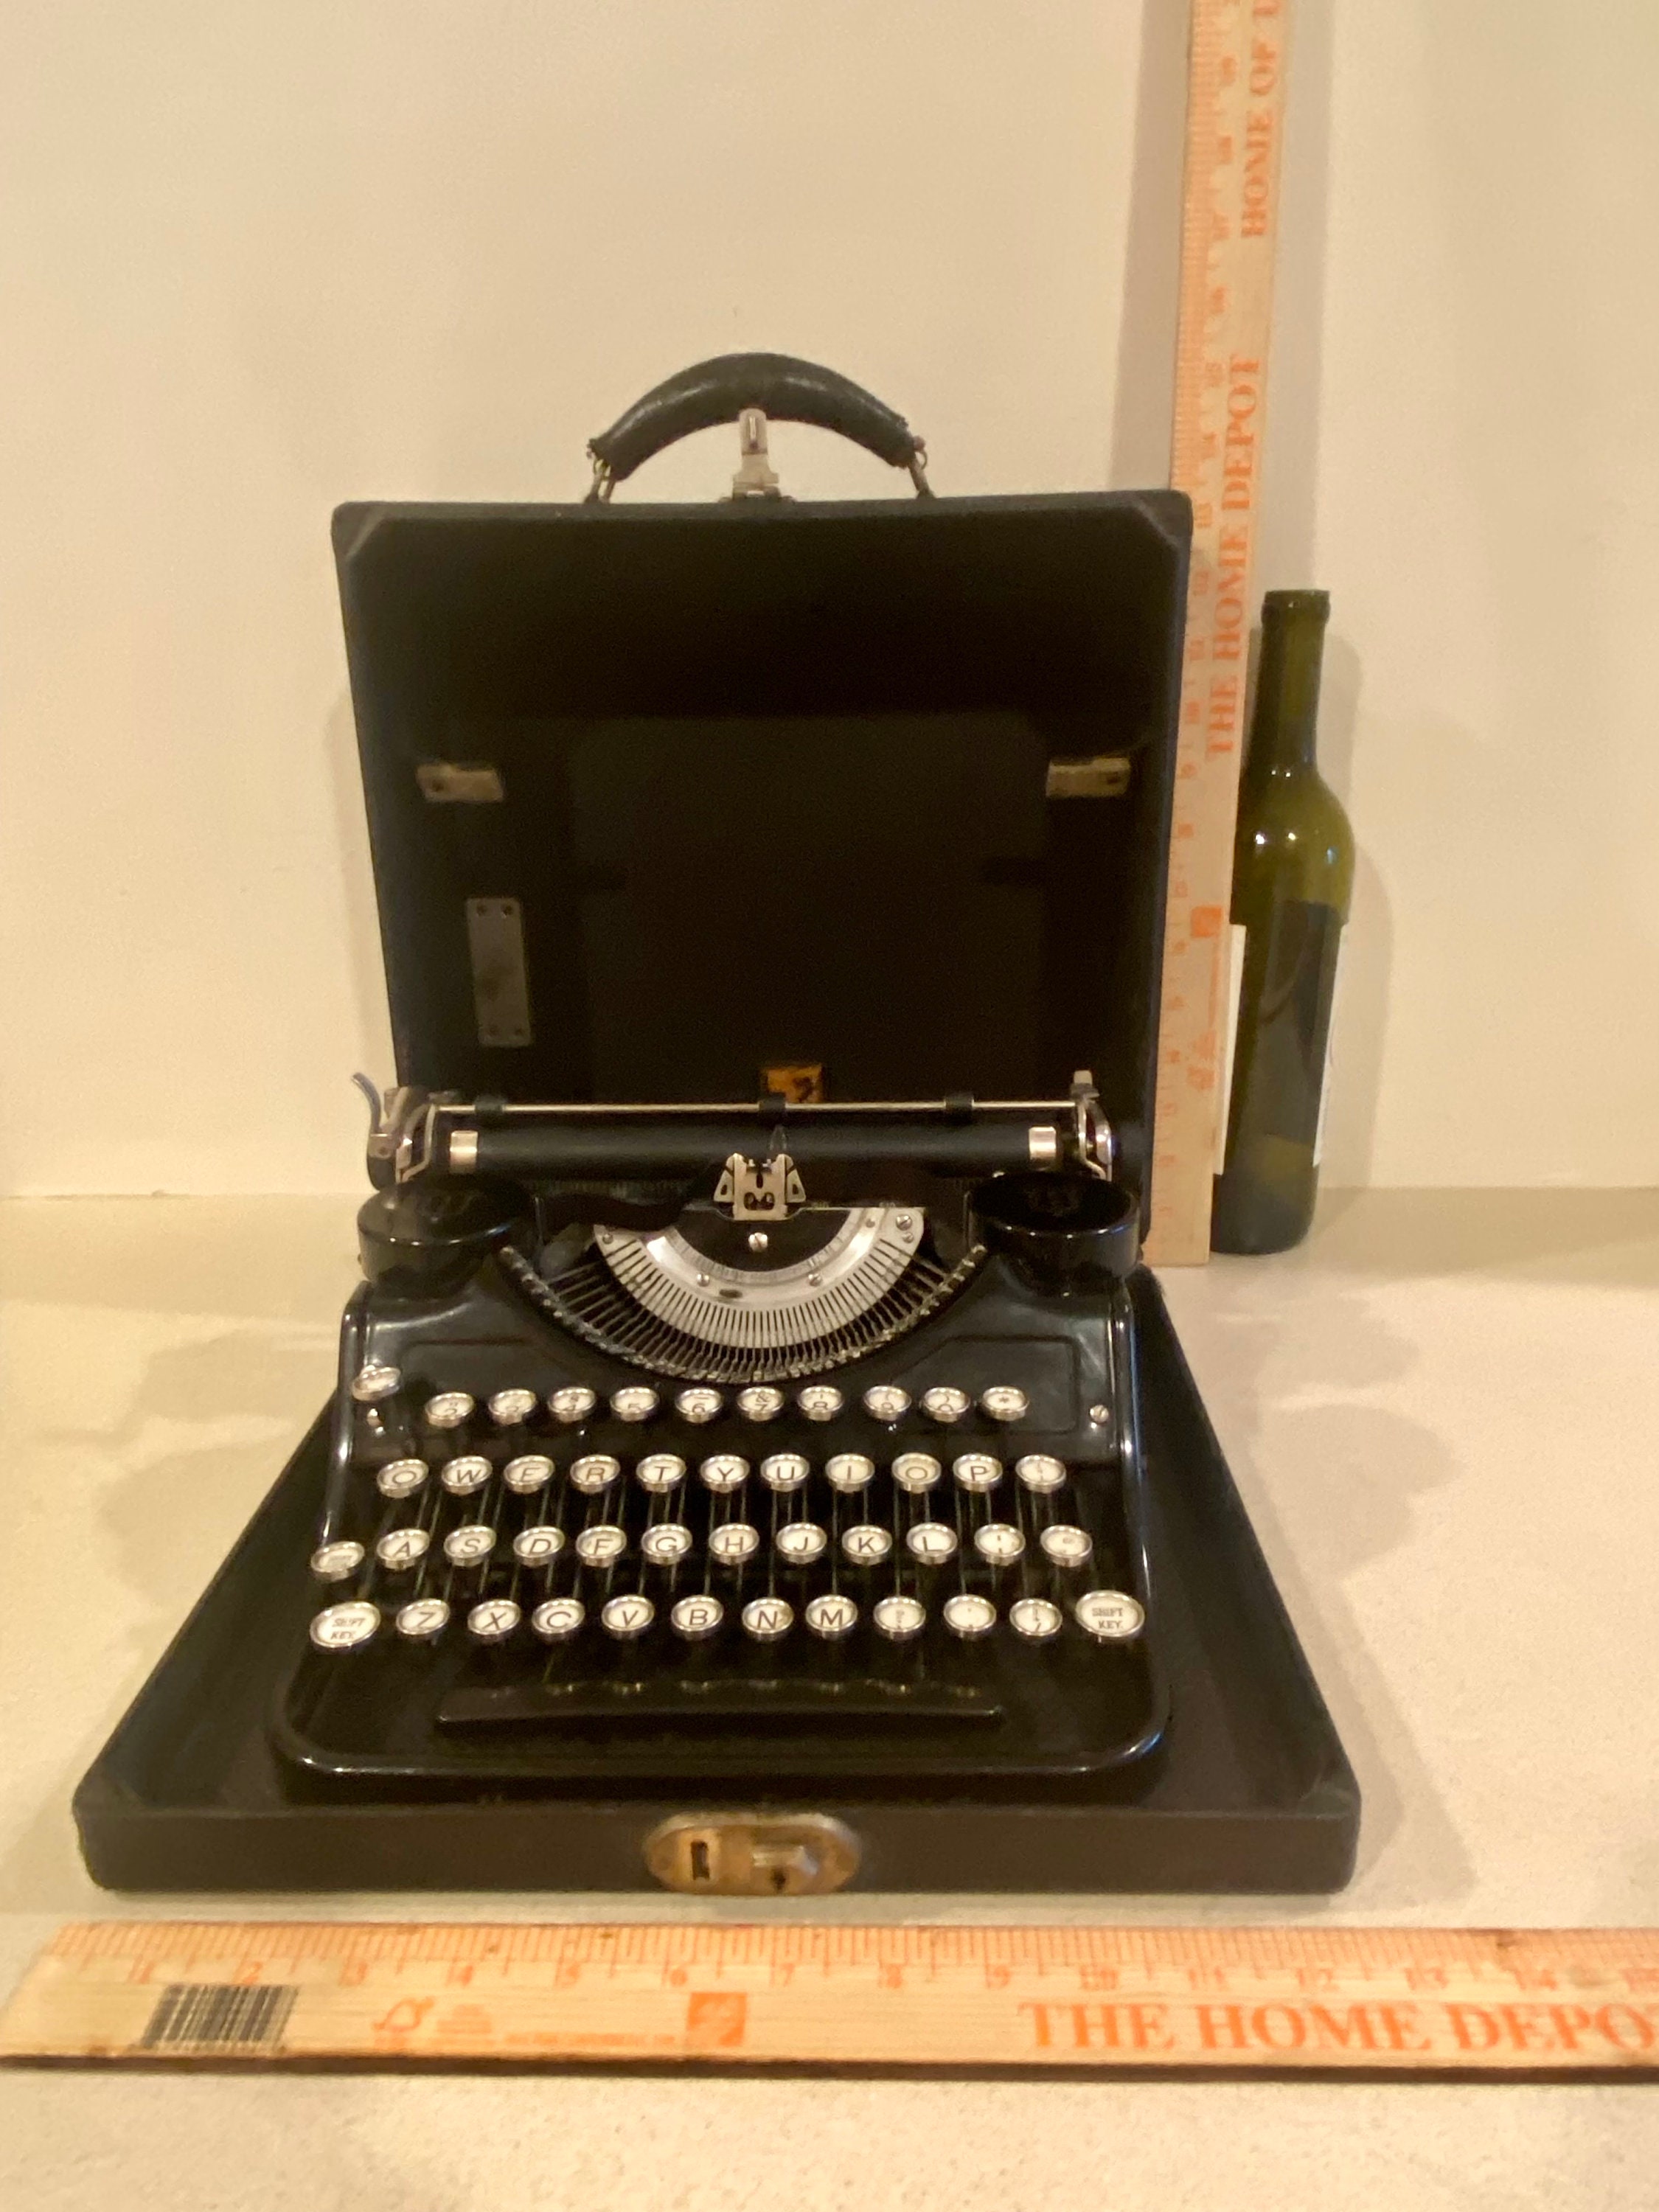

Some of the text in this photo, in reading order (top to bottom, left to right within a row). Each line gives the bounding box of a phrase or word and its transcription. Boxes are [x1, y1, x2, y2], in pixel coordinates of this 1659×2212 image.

[1205, 353, 1259, 762] THE HOME DEPOT
[393, 1536, 943, 1557] A S D F G H J K L
[483, 1612, 508, 1630] X
[546, 1611, 572, 1627] C
[620, 1610, 639, 1626] V
[689, 1609, 709, 1627] B
[757, 1610, 779, 1630] N
[820, 1608, 844, 1627] M
[1017, 2002, 1659, 2050] THE HOME DEPO
